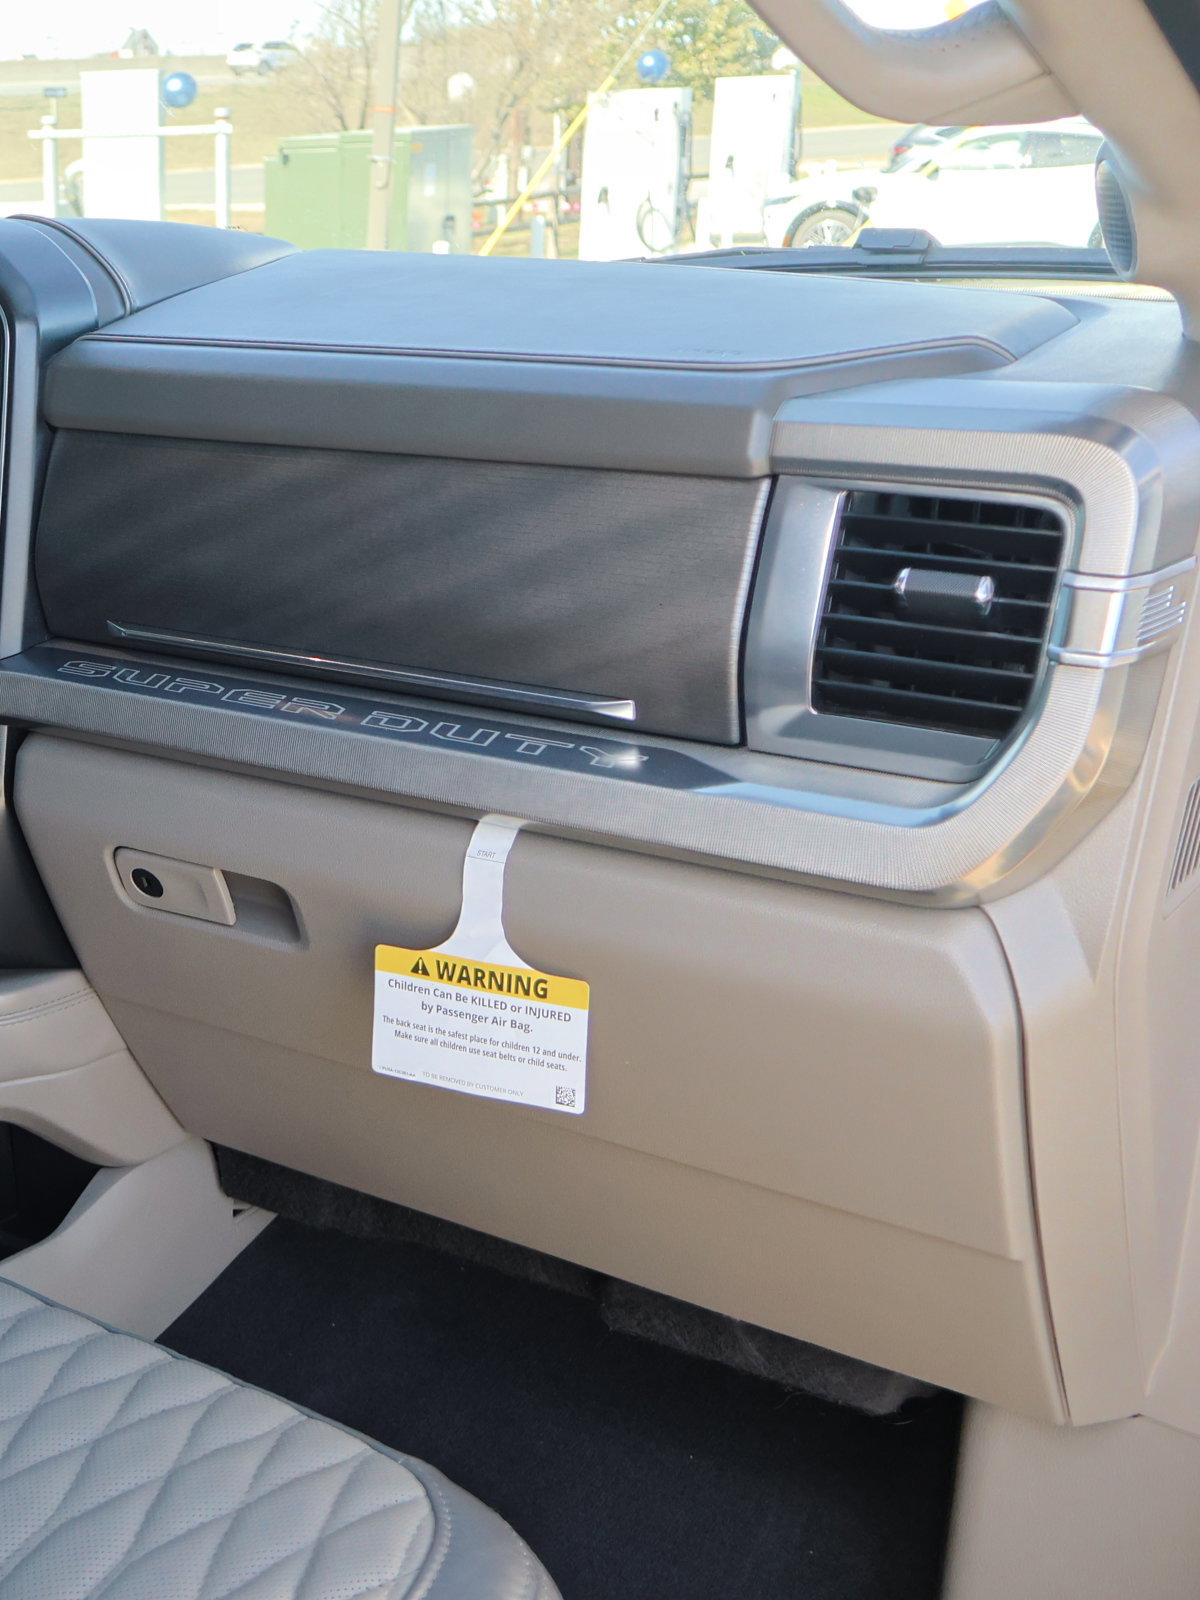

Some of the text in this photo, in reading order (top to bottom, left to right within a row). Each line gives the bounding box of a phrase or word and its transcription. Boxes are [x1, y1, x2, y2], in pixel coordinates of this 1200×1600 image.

[57, 660, 650, 768] SUPER DUTY
[476, 850, 497, 859] START
[435, 959, 549, 999] WARNING
[387, 978, 572, 1022] Children Can Be KILLED or INJURED
[421, 1001, 533, 1034] by Passenger Air Bag.
[382, 1015, 582, 1063] The back seat is the safest place for children 12 and under.
[394, 1029, 568, 1072] Make sure all children use seat belts or child seats.
[422, 1071, 524, 1097] TO BE REMOVED BY CUSTOMER ONLY
